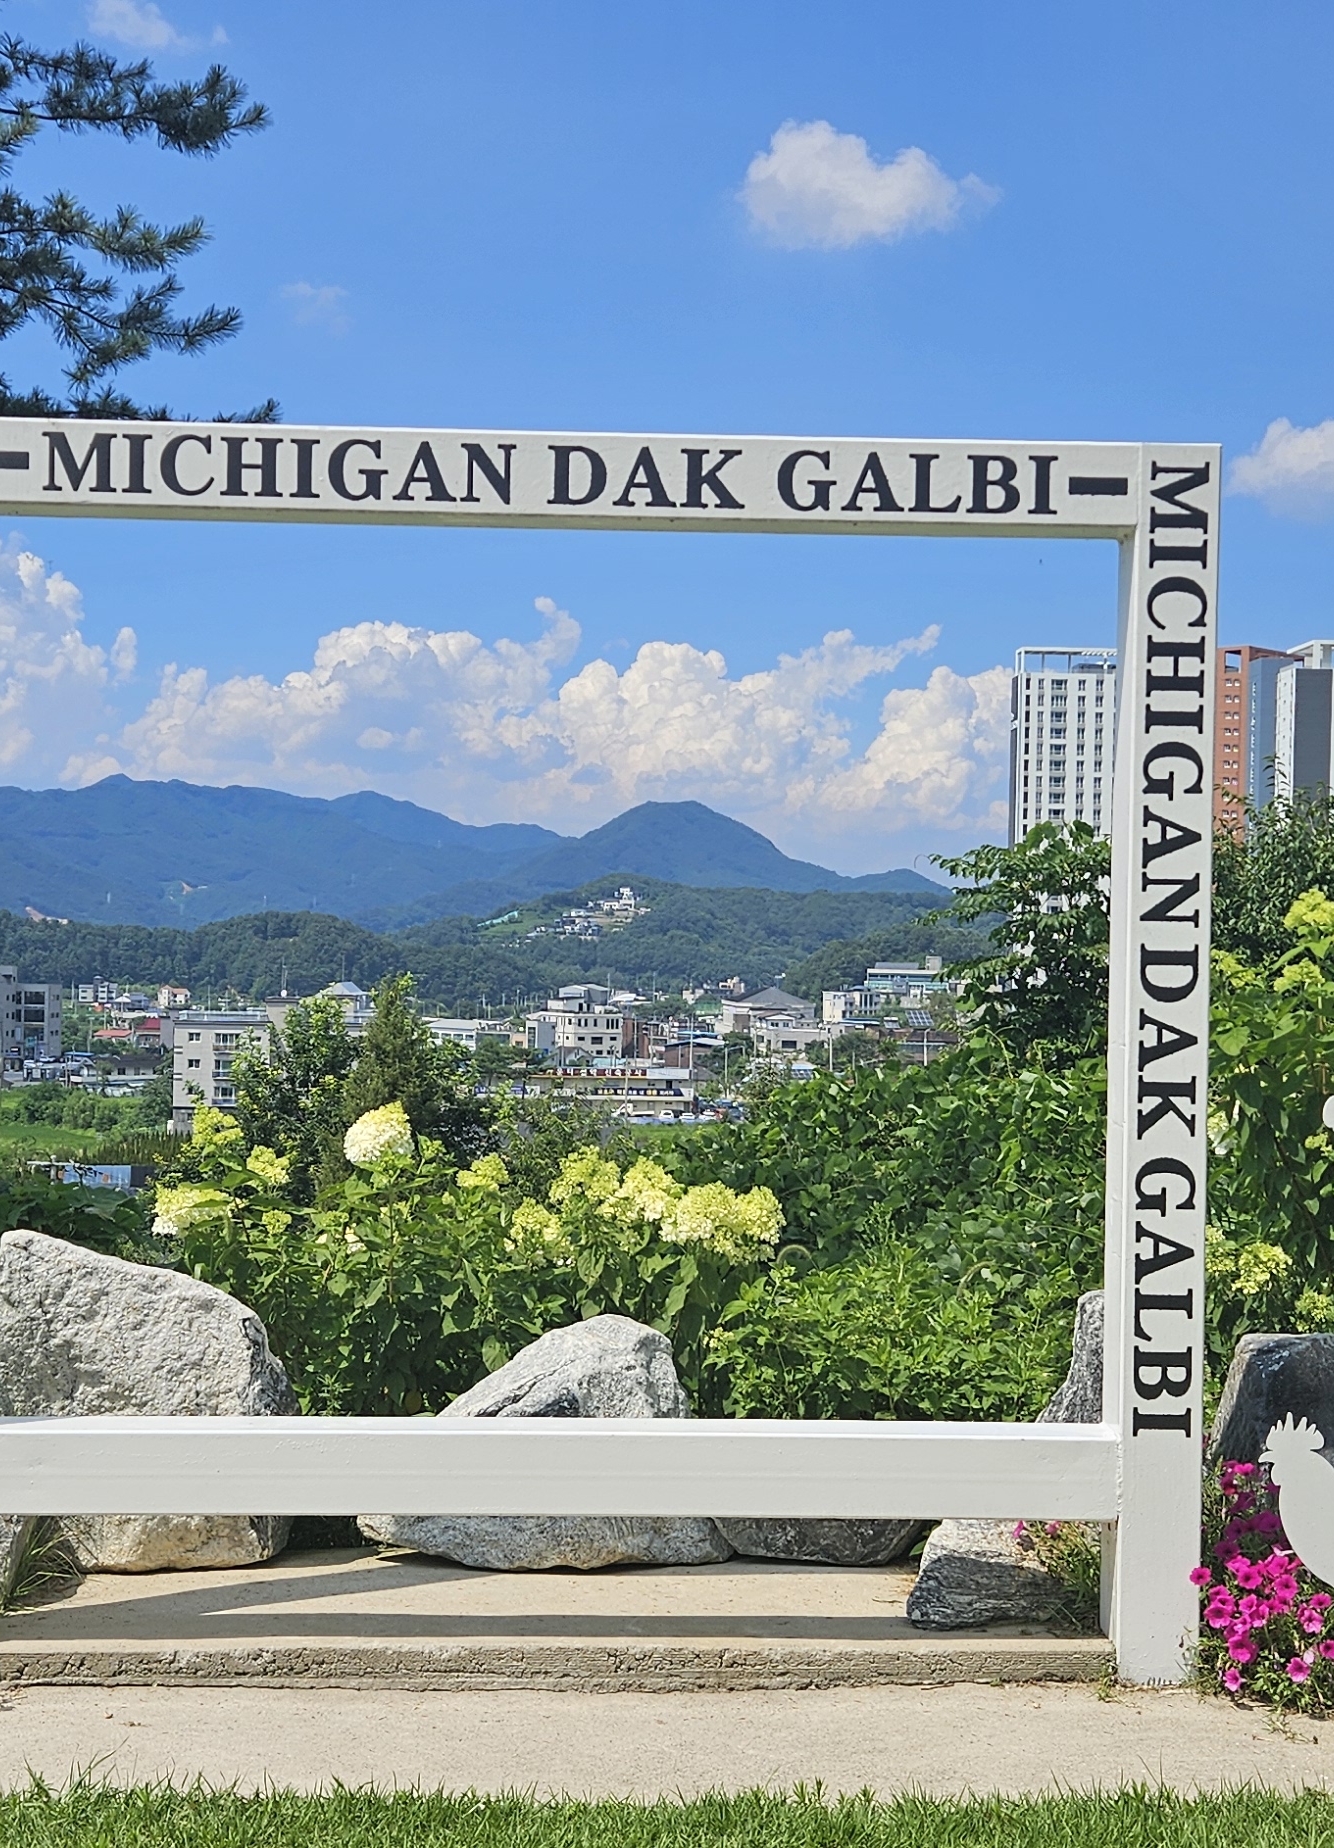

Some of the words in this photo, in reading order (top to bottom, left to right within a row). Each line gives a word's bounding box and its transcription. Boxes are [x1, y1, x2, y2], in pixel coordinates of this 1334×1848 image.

[42, 431, 517, 505] MICHIGAN
[546, 444, 746, 510] DAK
[777, 449, 1059, 515] GALBI
[1139, 460, 1211, 929] MICHIGAN
[1136, 942, 1199, 1141] DAK
[1132, 1156, 1196, 1438] GALBI
